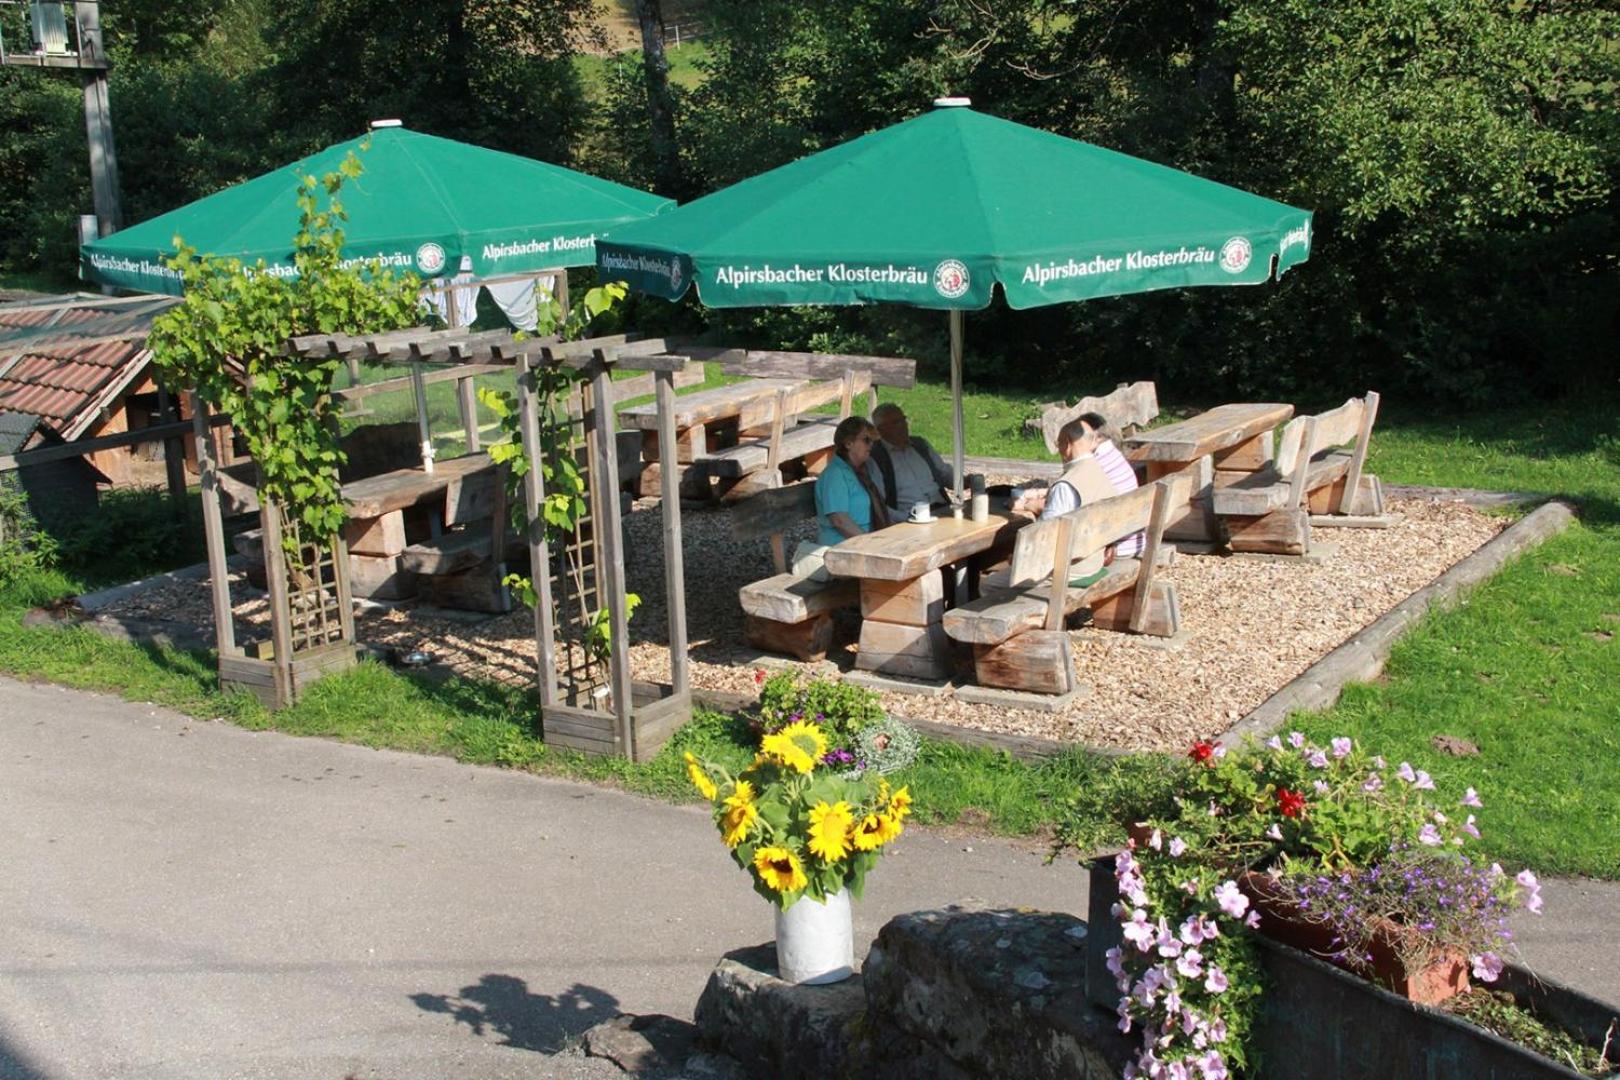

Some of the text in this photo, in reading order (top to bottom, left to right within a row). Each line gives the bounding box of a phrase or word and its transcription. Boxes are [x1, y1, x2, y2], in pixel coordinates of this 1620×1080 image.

[482, 233, 609, 261] Alpirsbacher Klosterb
[716, 264, 823, 289] Alpirsbacher
[828, 264, 928, 285] Klosterbräu
[1022, 253, 1122, 286] Alpirsbacher
[1126, 246, 1215, 270] Klosterbräu
